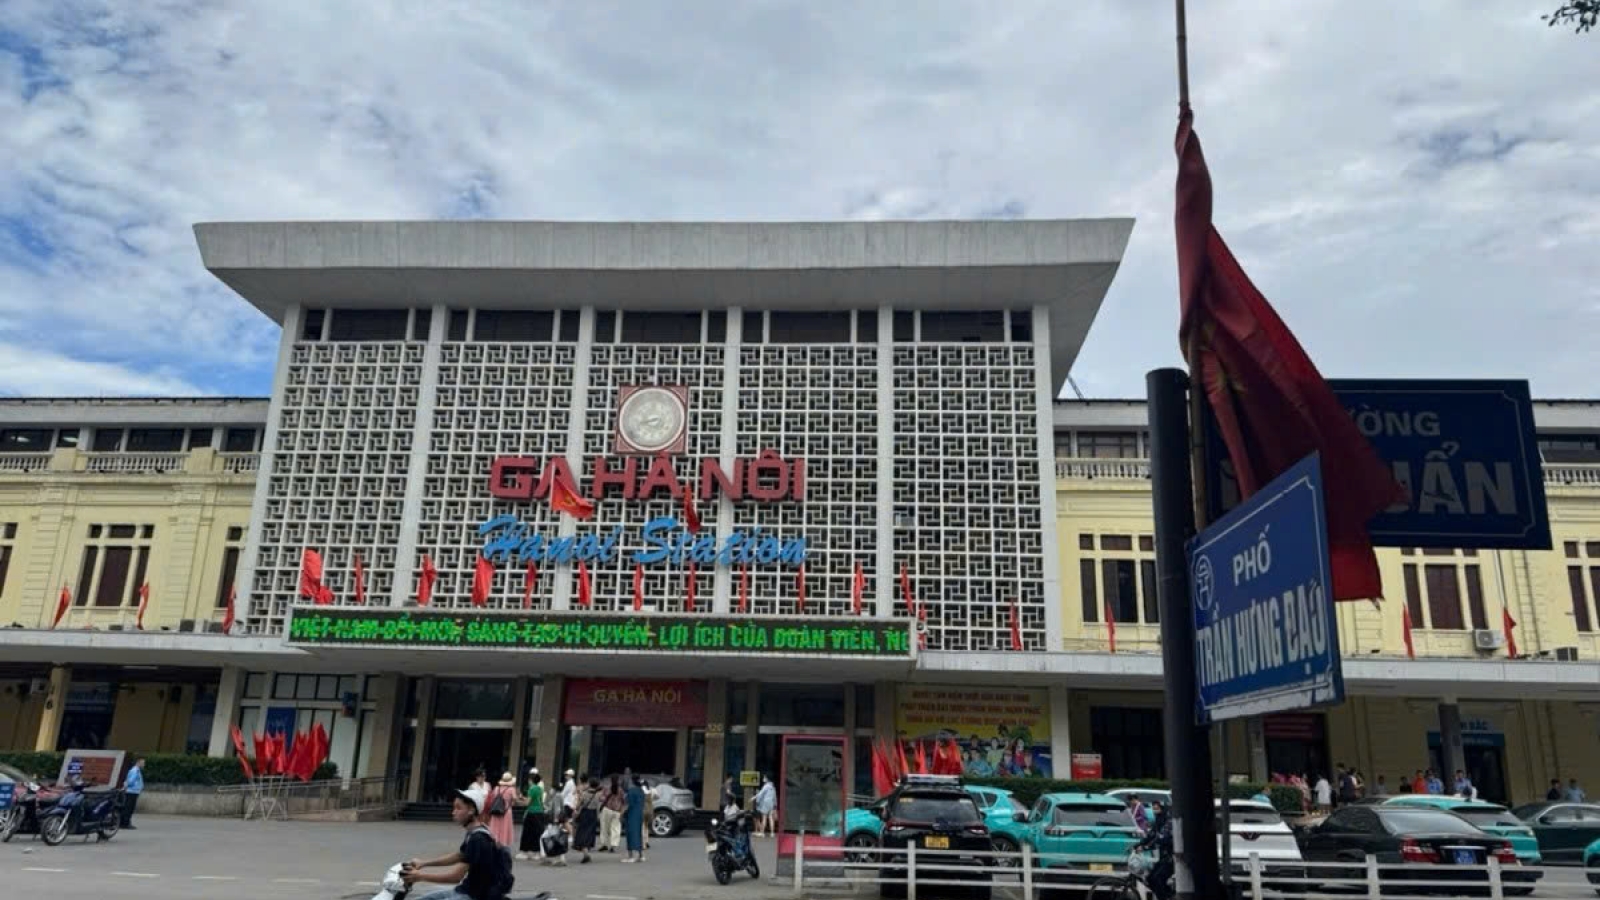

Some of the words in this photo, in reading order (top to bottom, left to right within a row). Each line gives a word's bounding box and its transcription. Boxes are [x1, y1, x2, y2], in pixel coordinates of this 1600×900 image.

[1347, 404, 1441, 437] ỜNG
[490, 456, 580, 498] GA
[592, 450, 685, 499] HÀ
[479, 514, 623, 564] Hanoi
[632, 516, 806, 565] Station
[1233, 523, 1271, 586] PHỐ
[293, 614, 331, 641] VIỆT
[335, 618, 379, 640] NAM
[467, 617, 519, 644] SÁNG
[659, 623, 689, 650] LỢI
[694, 621, 725, 648] ÍCH
[730, 621, 769, 649] CỦA
[774, 624, 826, 650] ĐOÀN
[1196, 602, 1235, 687] TRẦN
[1235, 596, 1284, 676] HƯNG
[594, 688, 619, 702] GA
[623, 685, 647, 703] HÀ
